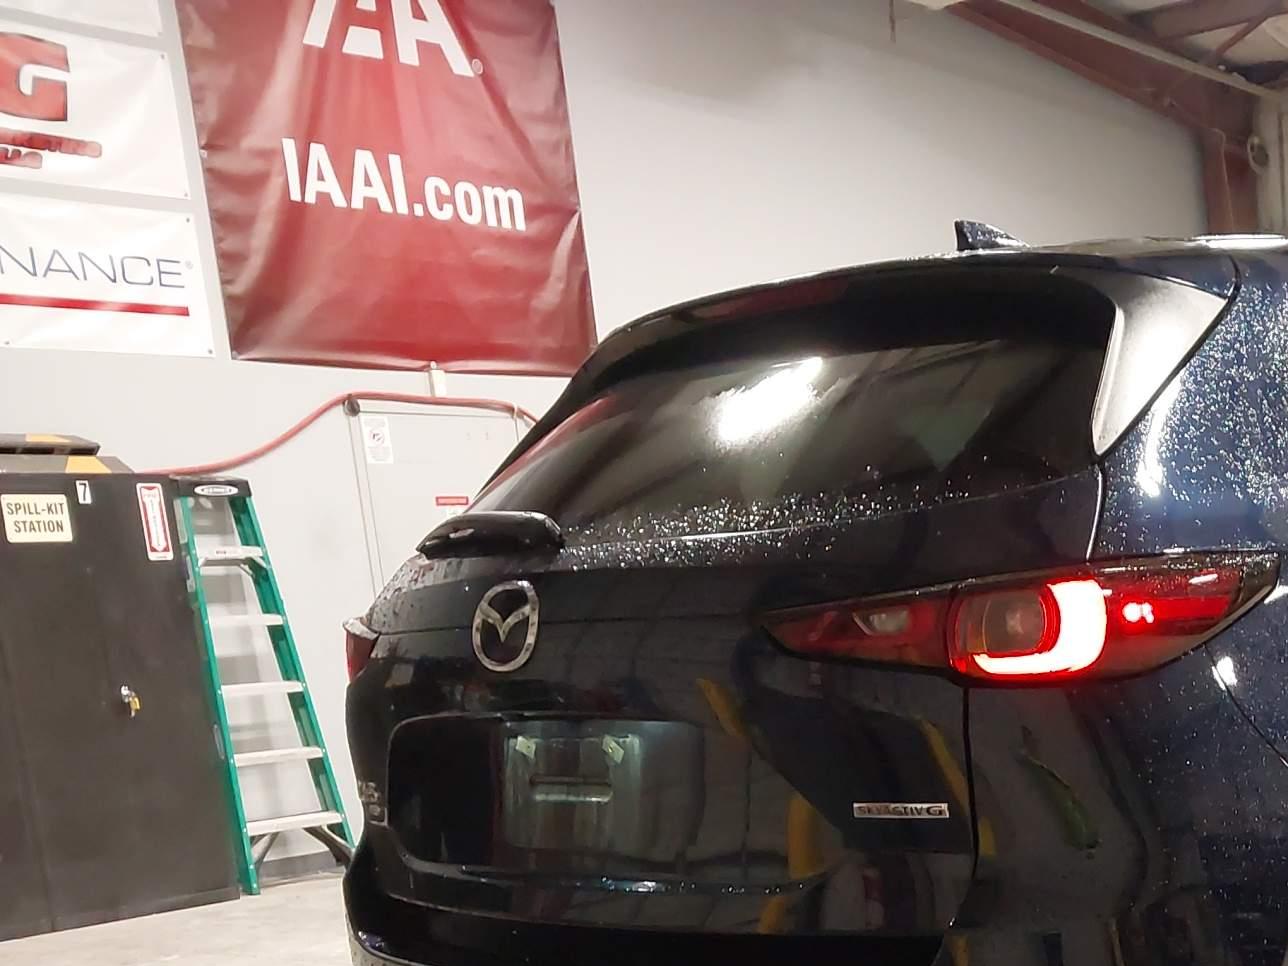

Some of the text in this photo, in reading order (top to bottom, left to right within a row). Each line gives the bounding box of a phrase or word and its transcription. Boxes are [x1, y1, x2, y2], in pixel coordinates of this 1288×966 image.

[281, 137, 527, 232] IAAI.com
[78, 482, 88, 503] 7
[6, 502, 65, 516] SPILL-KIT
[14, 520, 64, 534] STATION
